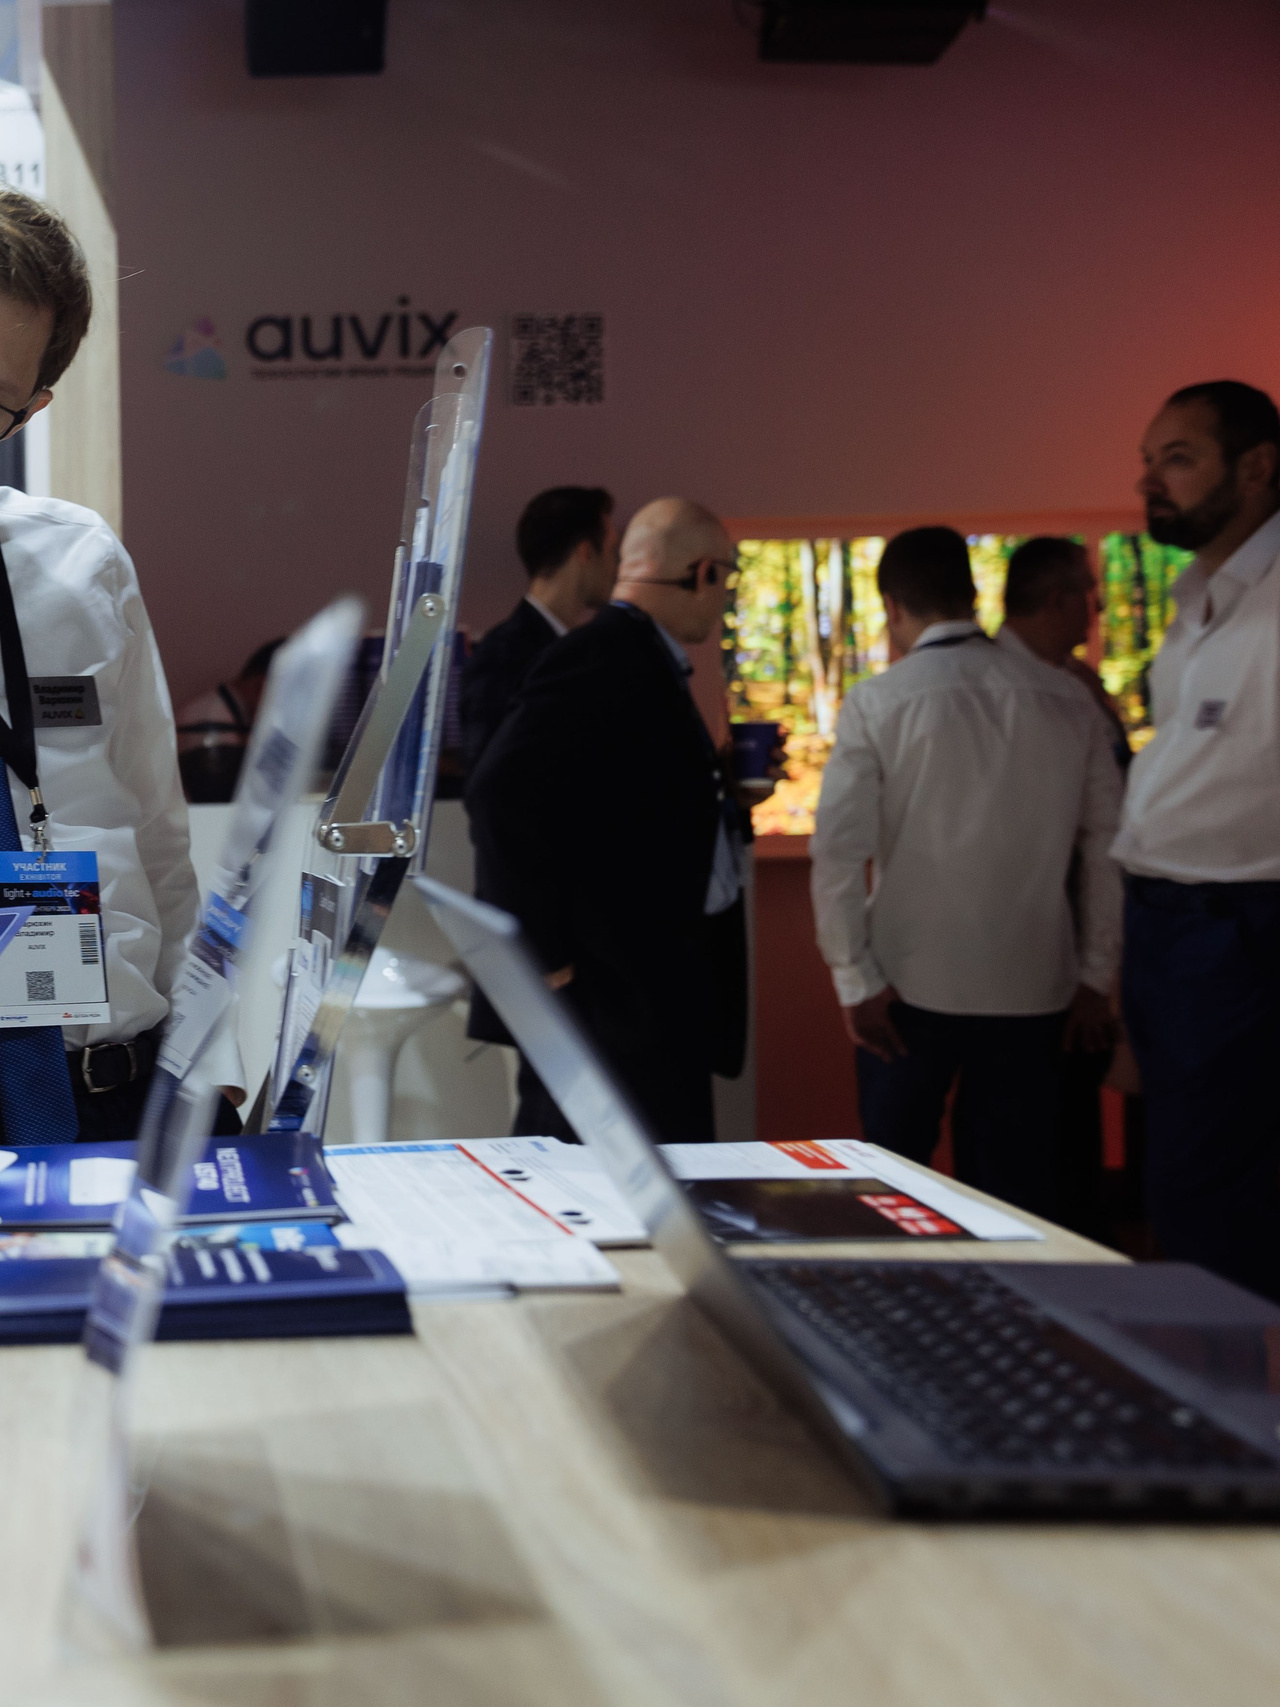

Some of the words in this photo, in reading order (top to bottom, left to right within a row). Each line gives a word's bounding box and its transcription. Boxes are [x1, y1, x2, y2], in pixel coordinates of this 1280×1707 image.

[245, 295, 459, 362] auvix
[12, 862, 67, 872] УЧАСТНИК
[20, 873, 62, 881] EXHIBITOR
